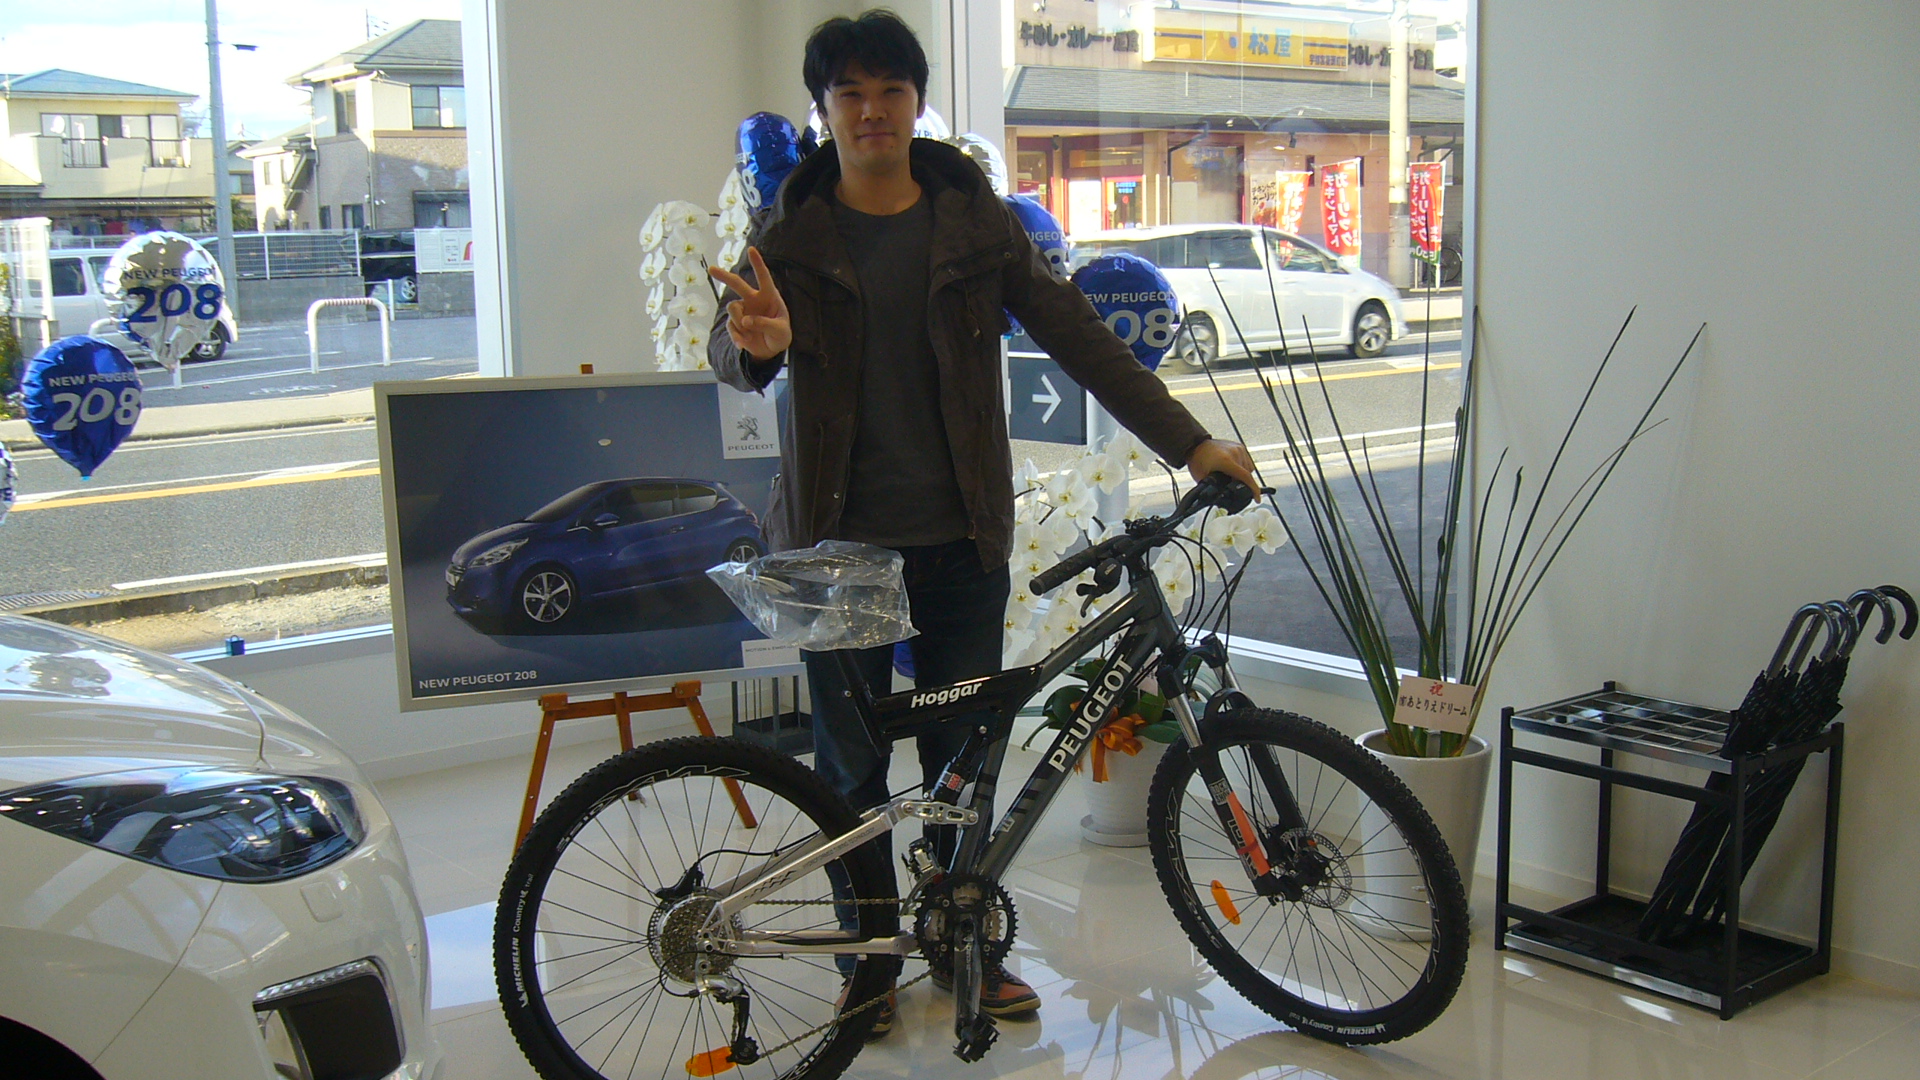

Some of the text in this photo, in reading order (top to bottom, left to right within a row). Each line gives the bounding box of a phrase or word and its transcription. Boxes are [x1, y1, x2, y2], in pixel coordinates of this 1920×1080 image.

[1248, 27, 1291, 57] 松屋
[123, 268, 158, 280] NEW
[128, 283, 221, 323] 208
[1087, 293, 1109, 304] EW
[1104, 307, 1175, 349] 08
[49, 375, 86, 388] NEW
[52, 387, 141, 431] 208
[727, 443, 775, 452] PEUGEOT
[419, 670, 538, 690] NEW PEUGEOT 208
[1429, 681, 1443, 696] 祝
[910, 682, 983, 709] Hoggar
[1048, 654, 1133, 774] PEUGEOT
[513, 899, 526, 933] Country
[512, 937, 524, 992] MICHELIN
[1336, 1025, 1376, 1035] MICHELIN
